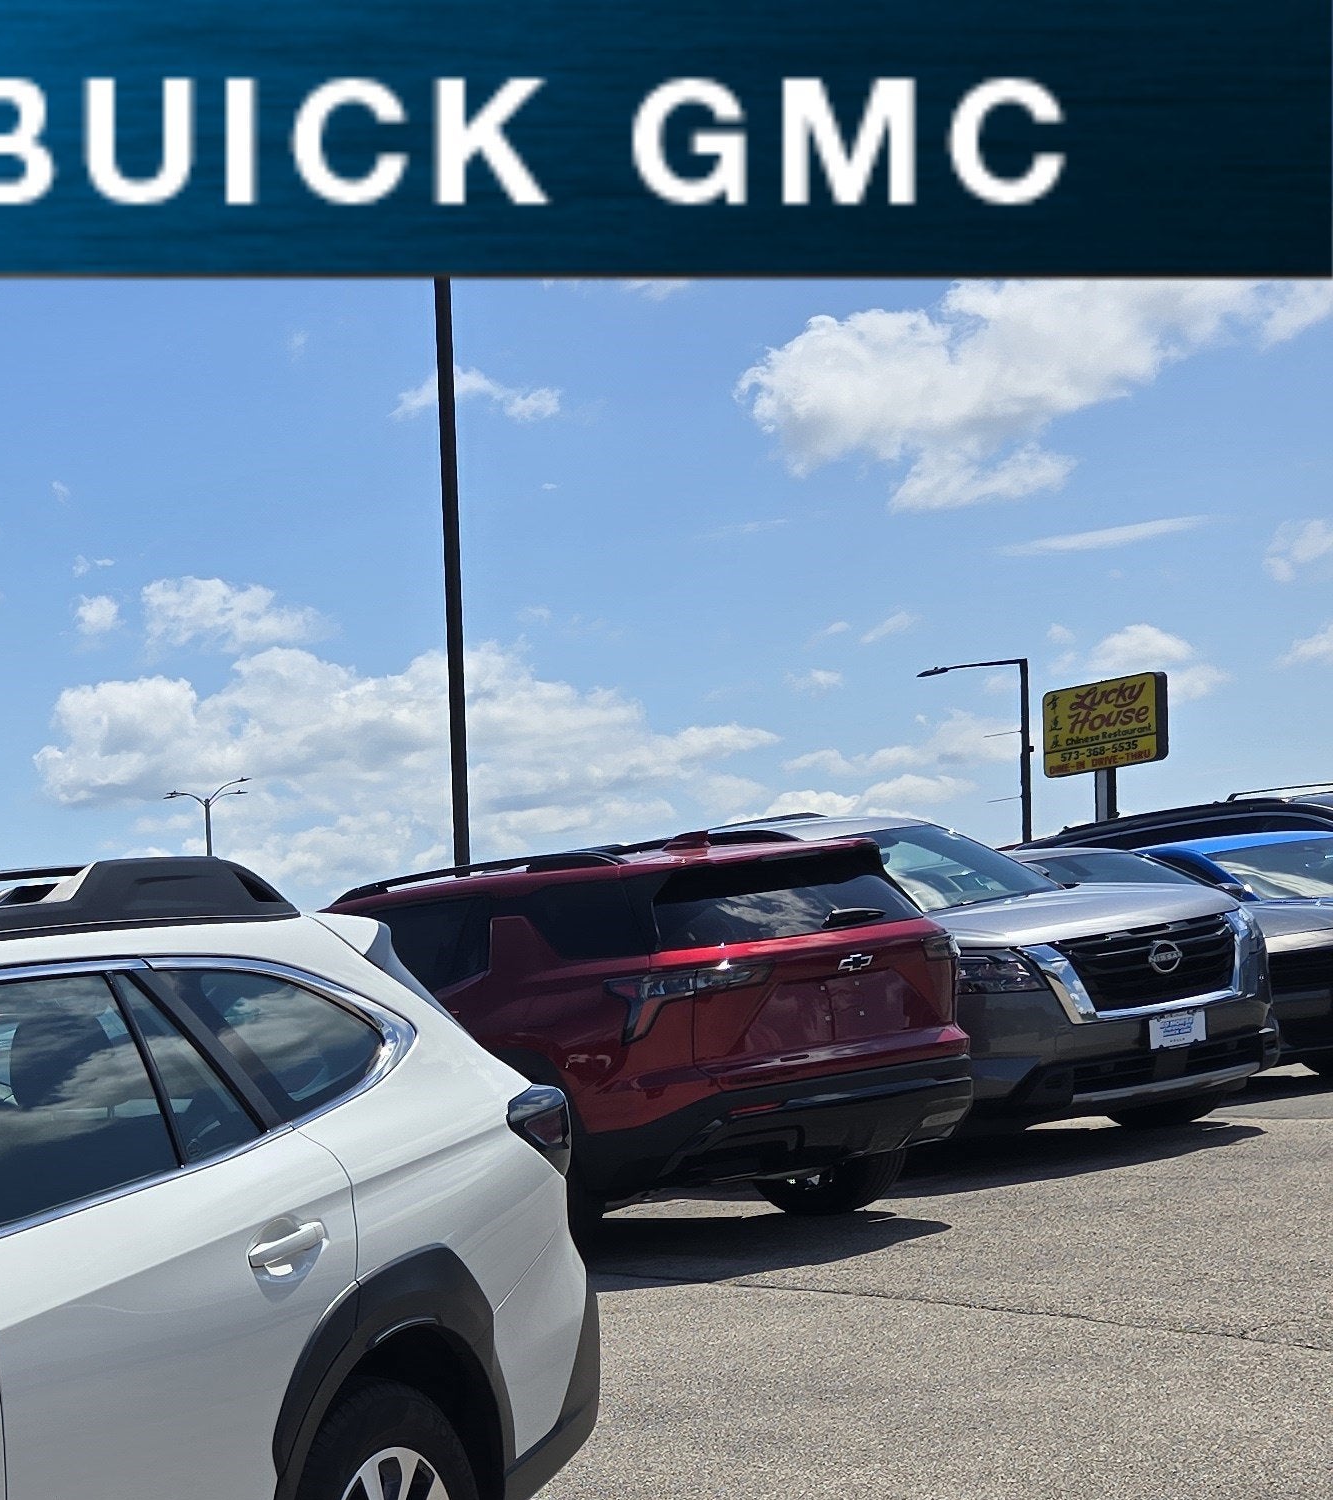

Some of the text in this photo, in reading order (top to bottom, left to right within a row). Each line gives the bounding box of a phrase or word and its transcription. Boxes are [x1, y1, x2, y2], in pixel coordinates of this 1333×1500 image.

[1069, 681, 1146, 712] Lucky
[1068, 704, 1149, 735] House
[1065, 722, 1152, 746] Chinese Restaurant
[1091, 749, 1151, 768] DRIVE-THRU
[1148, 950, 1183, 963] NISSAN
